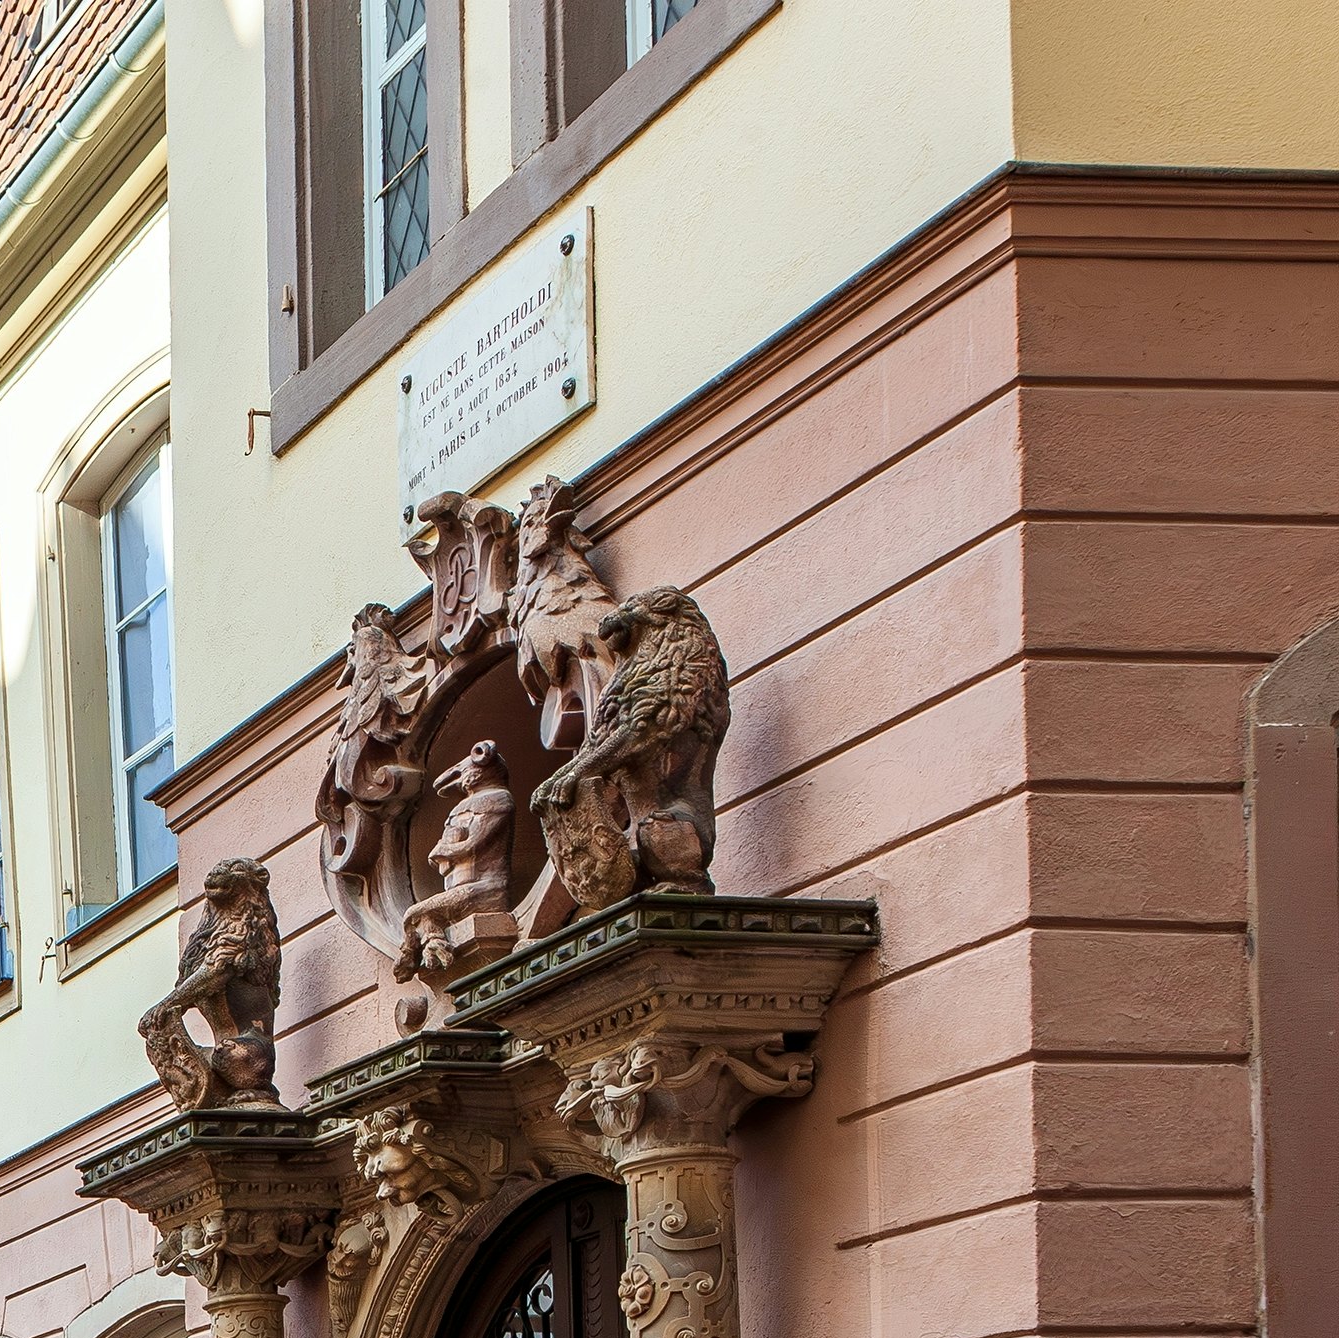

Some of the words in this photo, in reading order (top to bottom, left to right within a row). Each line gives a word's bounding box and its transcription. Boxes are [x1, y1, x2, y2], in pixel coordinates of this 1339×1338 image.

[418, 352, 468, 409] AUGUSTE
[476, 281, 552, 357] BARTHOLDI
[423, 407, 436, 428] EST
[440, 391, 450, 412] NÉ
[454, 374, 474, 399] DANS
[478, 347, 506, 378] CETTE
[510, 316, 546, 353] MAISON
[408, 466, 427, 492] MORT
[430, 455, 436, 472] À
[438, 431, 466, 465] PARIS
[470, 420, 480, 438] LE
[485, 409, 491, 426] 4
[496, 376, 538, 417] OCTOBRE
[543, 352, 569, 382] 1904
[443, 417, 454, 435] LE
[458, 407, 464, 421] 2
[468, 387, 490, 414] AOÛT
